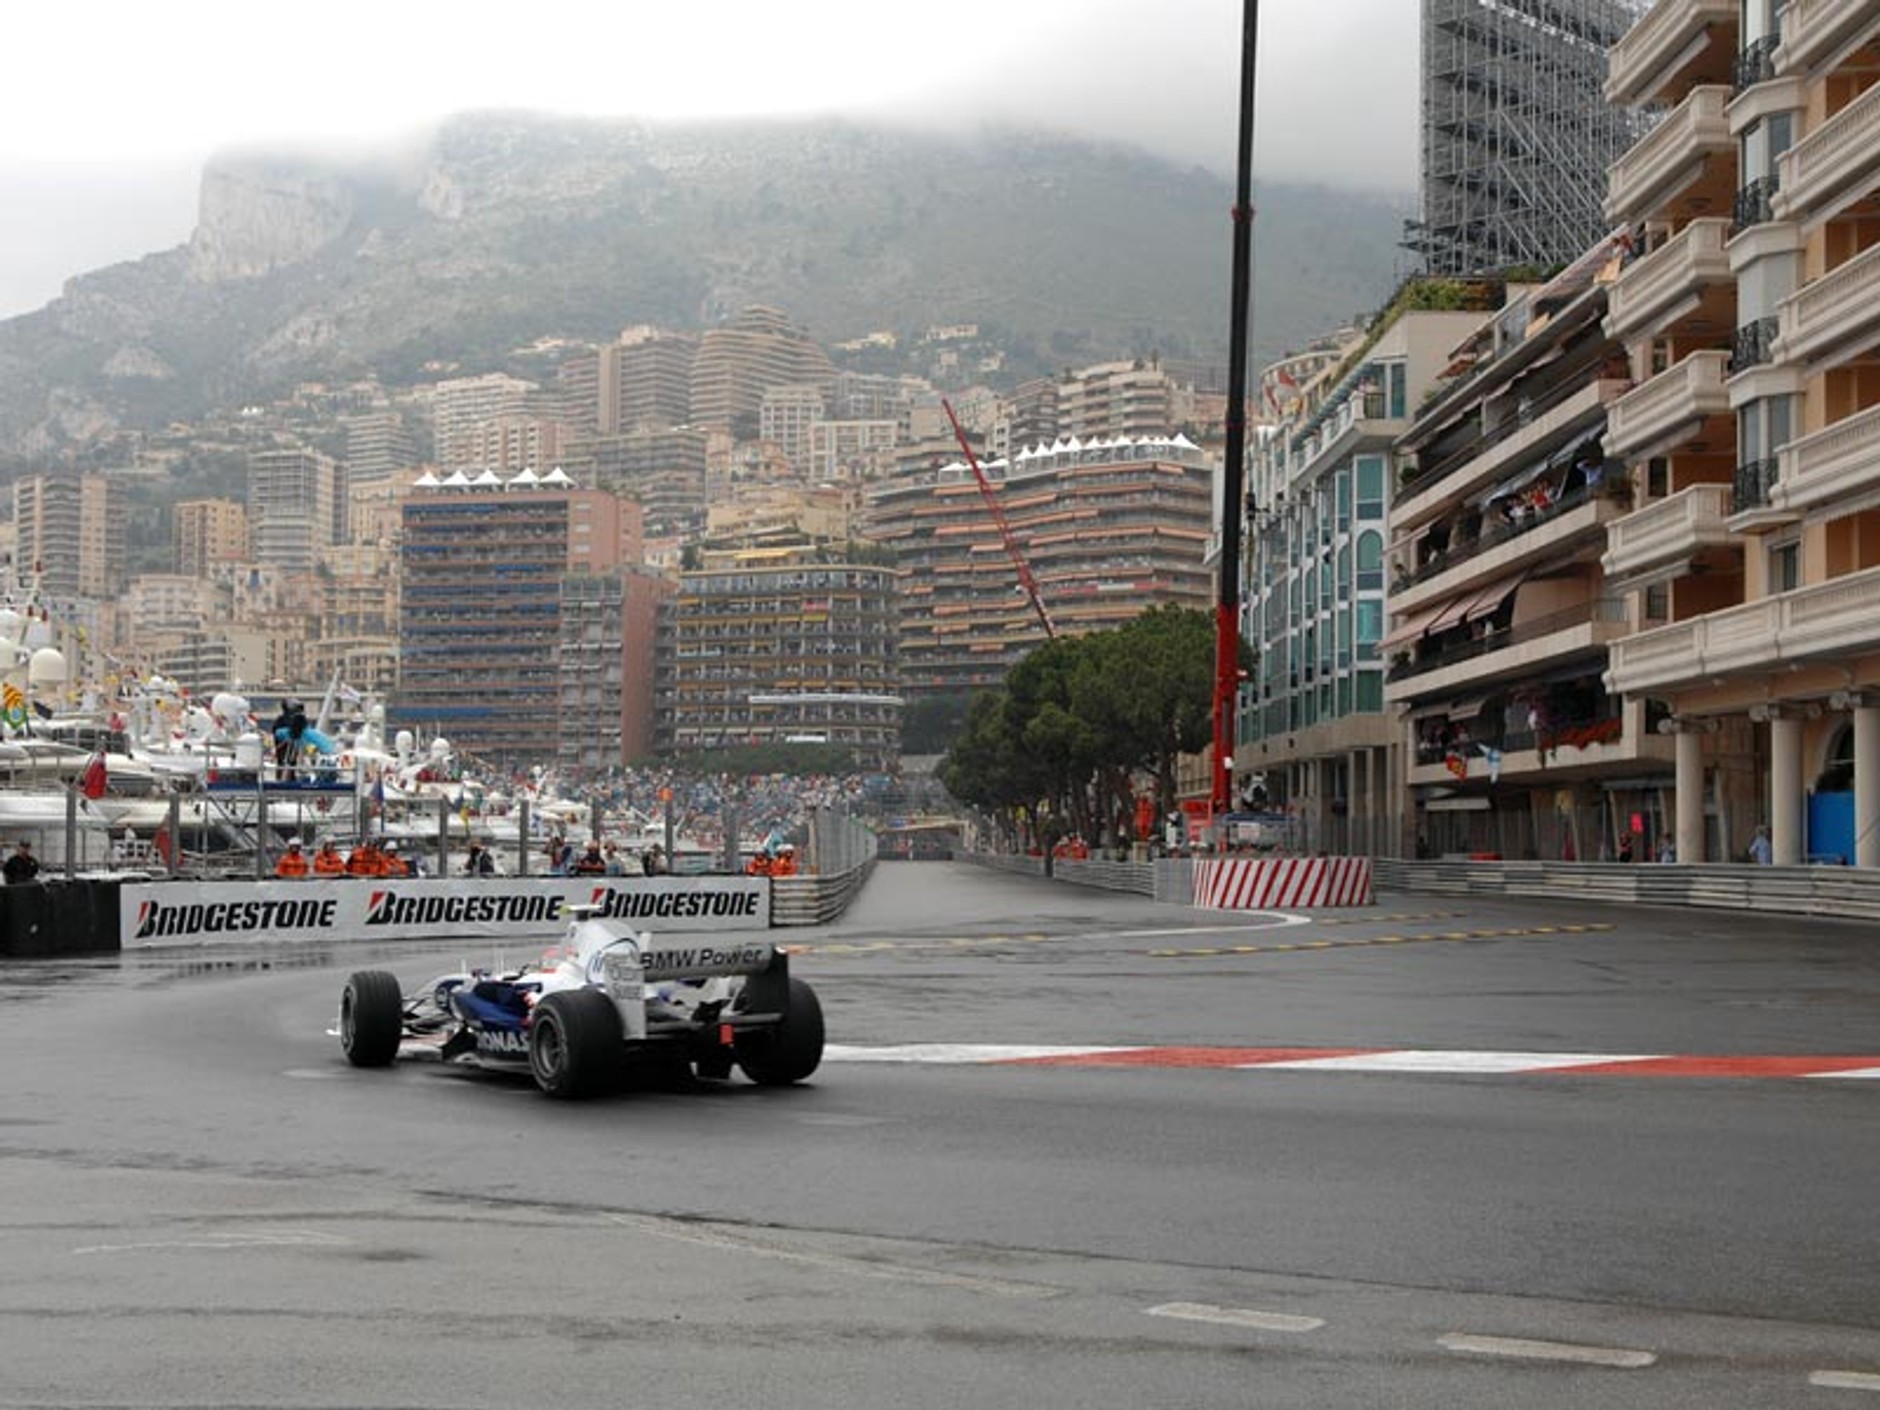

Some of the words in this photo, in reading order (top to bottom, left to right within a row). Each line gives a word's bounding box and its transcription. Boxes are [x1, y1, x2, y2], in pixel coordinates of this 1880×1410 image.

[135, 899, 338, 939] BRIDGESTONE
[364, 890, 566, 925] BRIDGESTONE
[590, 888, 760, 919] BRIDGESTONE
[639, 951, 696, 970] BMW
[700, 947, 764, 966] Power
